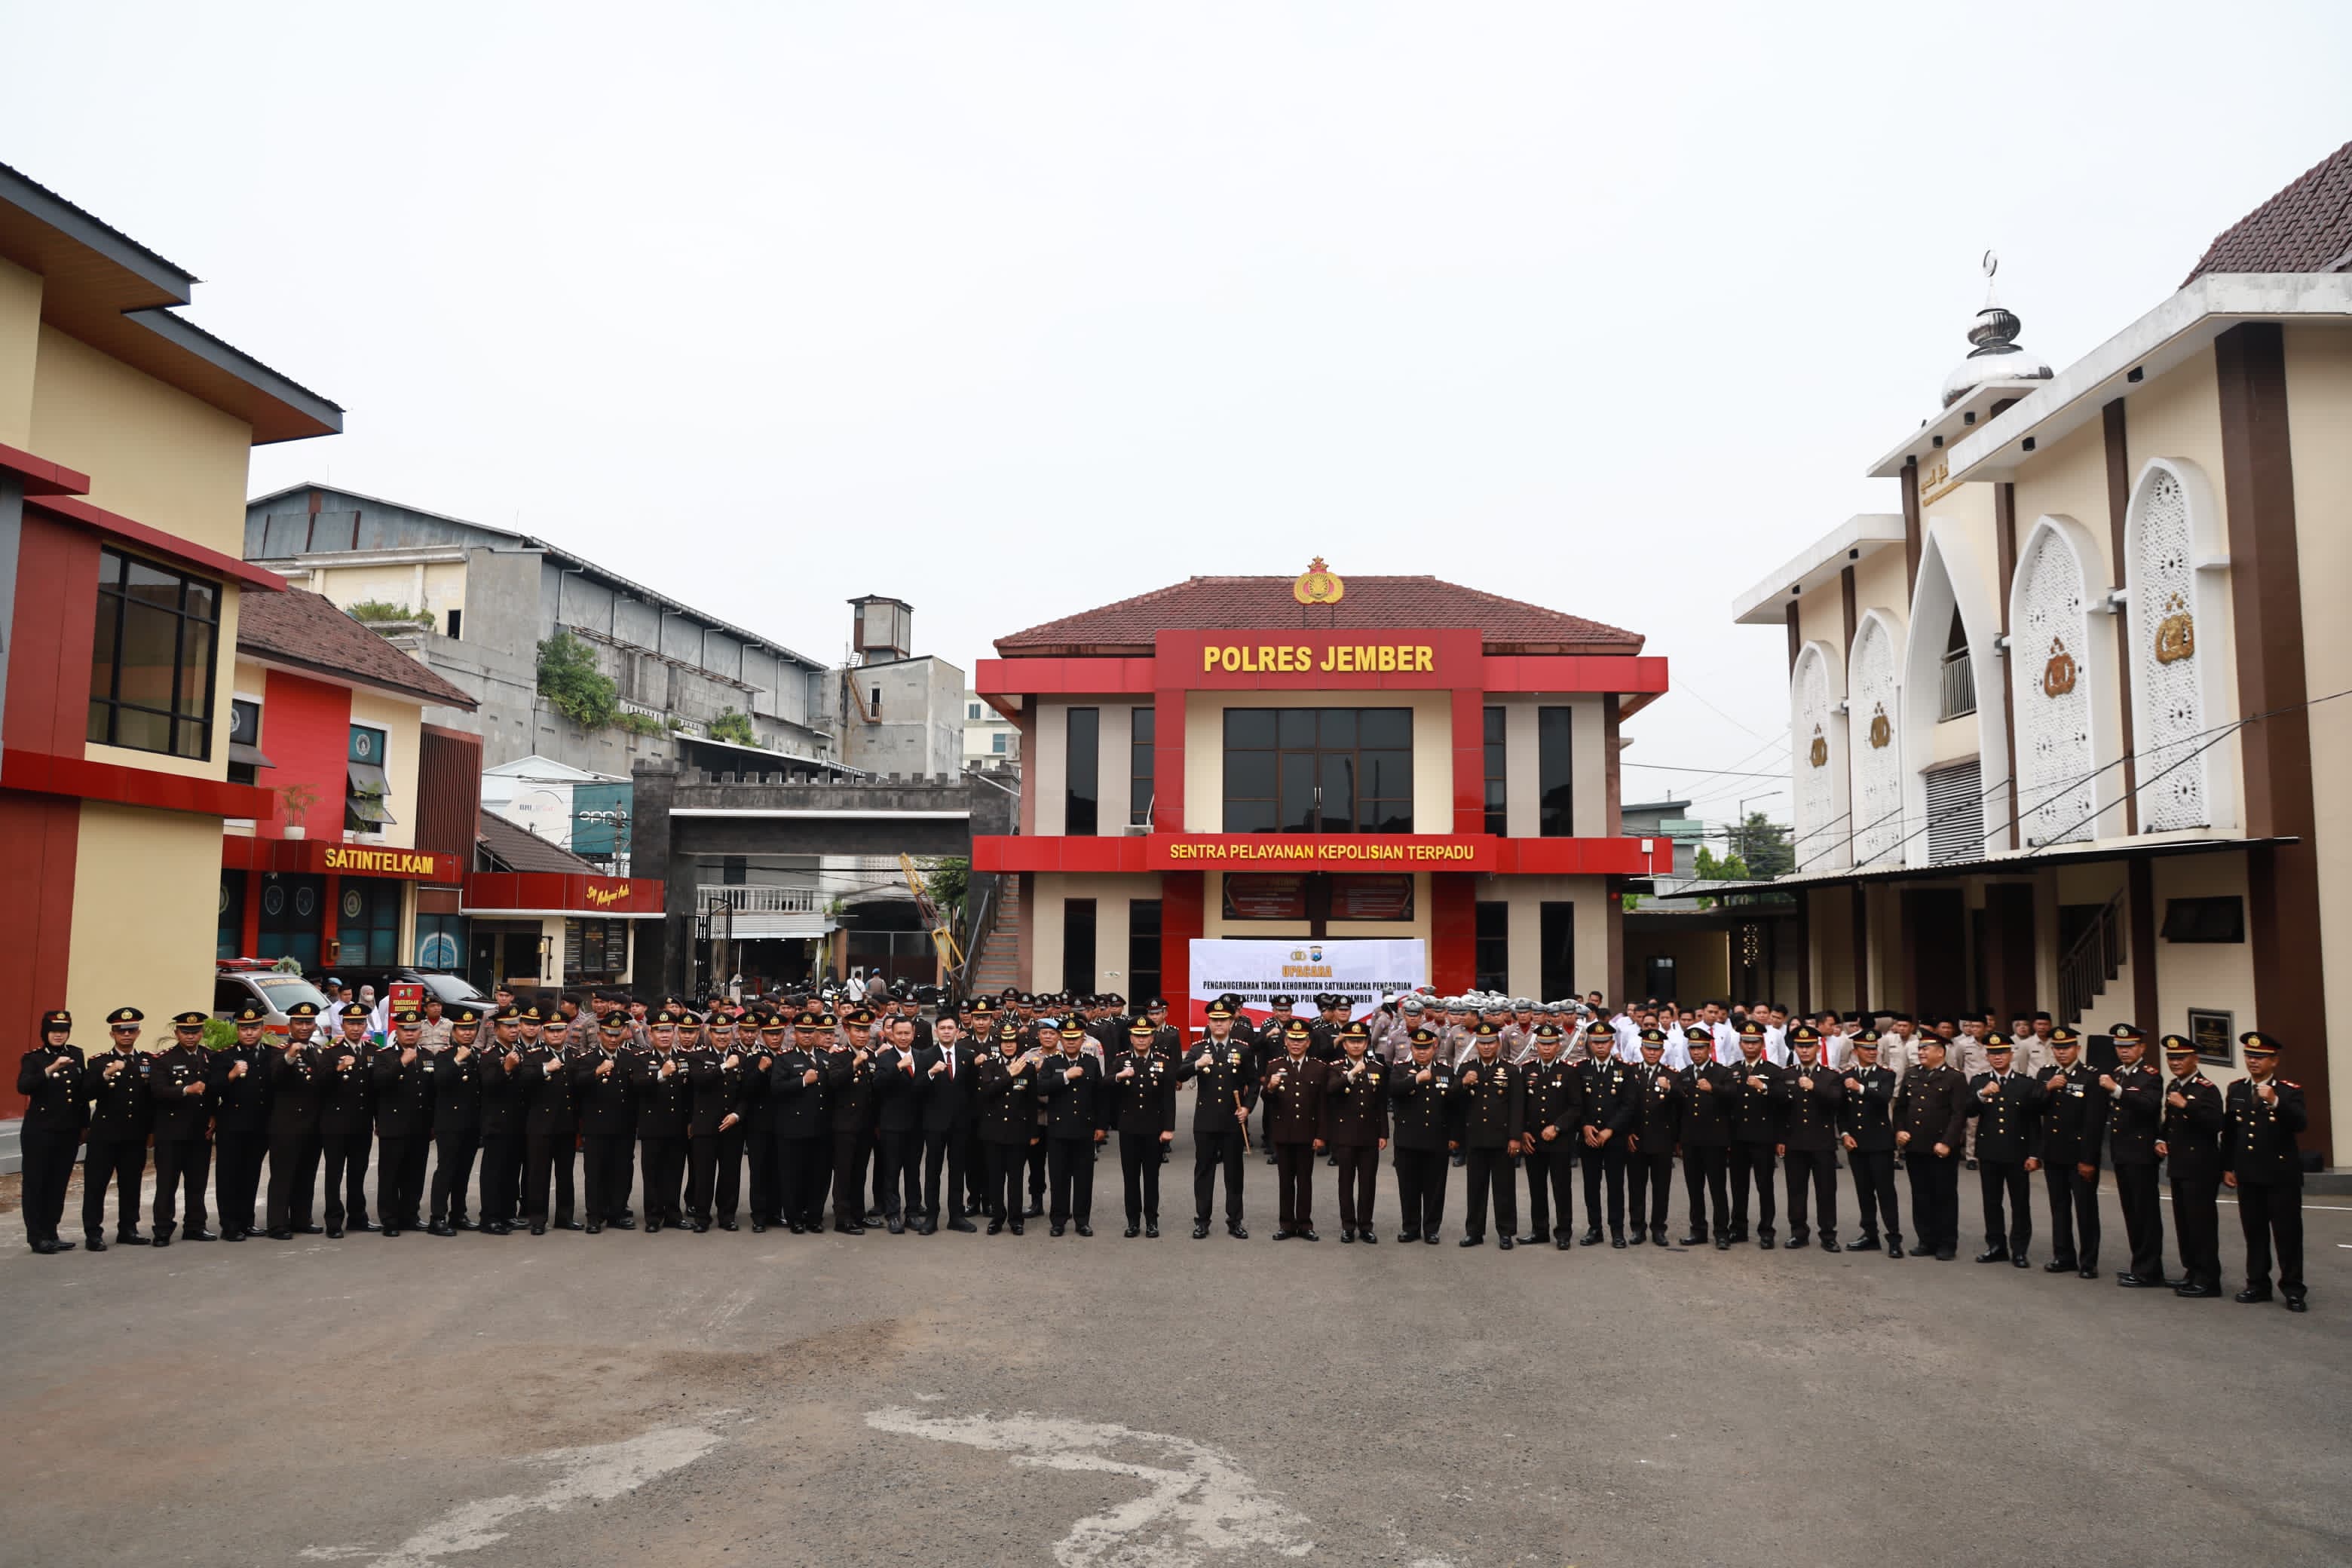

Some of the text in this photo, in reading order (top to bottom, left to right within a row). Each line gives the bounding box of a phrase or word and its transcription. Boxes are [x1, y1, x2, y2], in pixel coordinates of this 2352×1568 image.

[1204, 645, 1434, 672] POLRES JEMBER
[1170, 844, 1475, 861] SENTRA PELAYANAN KEPOLISIAN TERPADU
[325, 848, 434, 876] SATINTELKAM
[1282, 965, 1333, 978] UPACARA
[1202, 982, 1260, 991] PENGANUGERAHAN
[1260, 982, 1281, 991] TANDA
[1282, 982, 1323, 991] KEHORMATAN
[1325, 982, 1371, 991] SATYALANCANA
